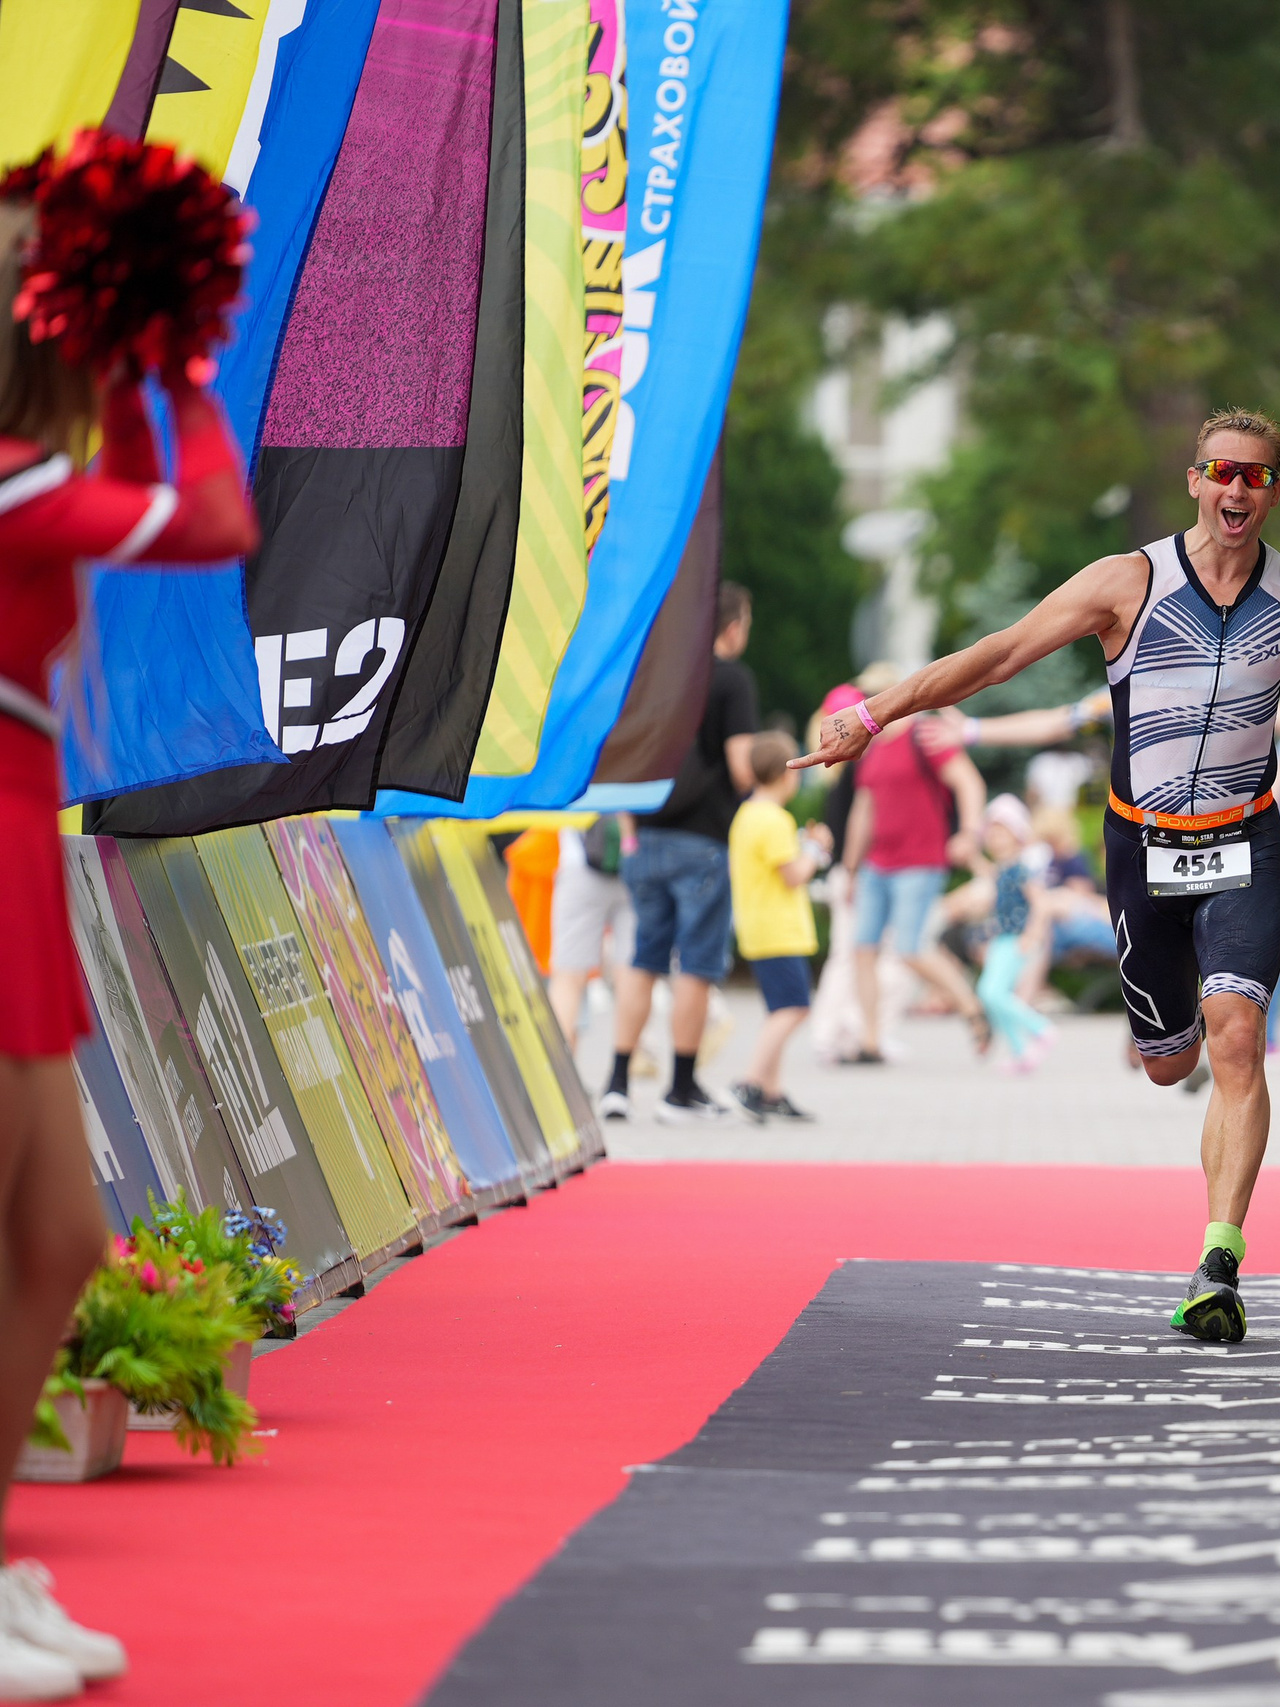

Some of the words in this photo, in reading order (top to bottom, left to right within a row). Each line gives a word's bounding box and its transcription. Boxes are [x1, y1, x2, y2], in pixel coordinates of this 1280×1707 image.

[254, 616, 406, 755] E2
[833, 718, 850, 740] 454
[1156, 808, 1243, 828] POWERUP
[1181, 835, 1195, 843] IRON
[1200, 832, 1214, 842] STAR
[1172, 851, 1225, 877] 454
[1185, 881, 1213, 891] SERGEY
[196, 939, 298, 1178] TELE2
